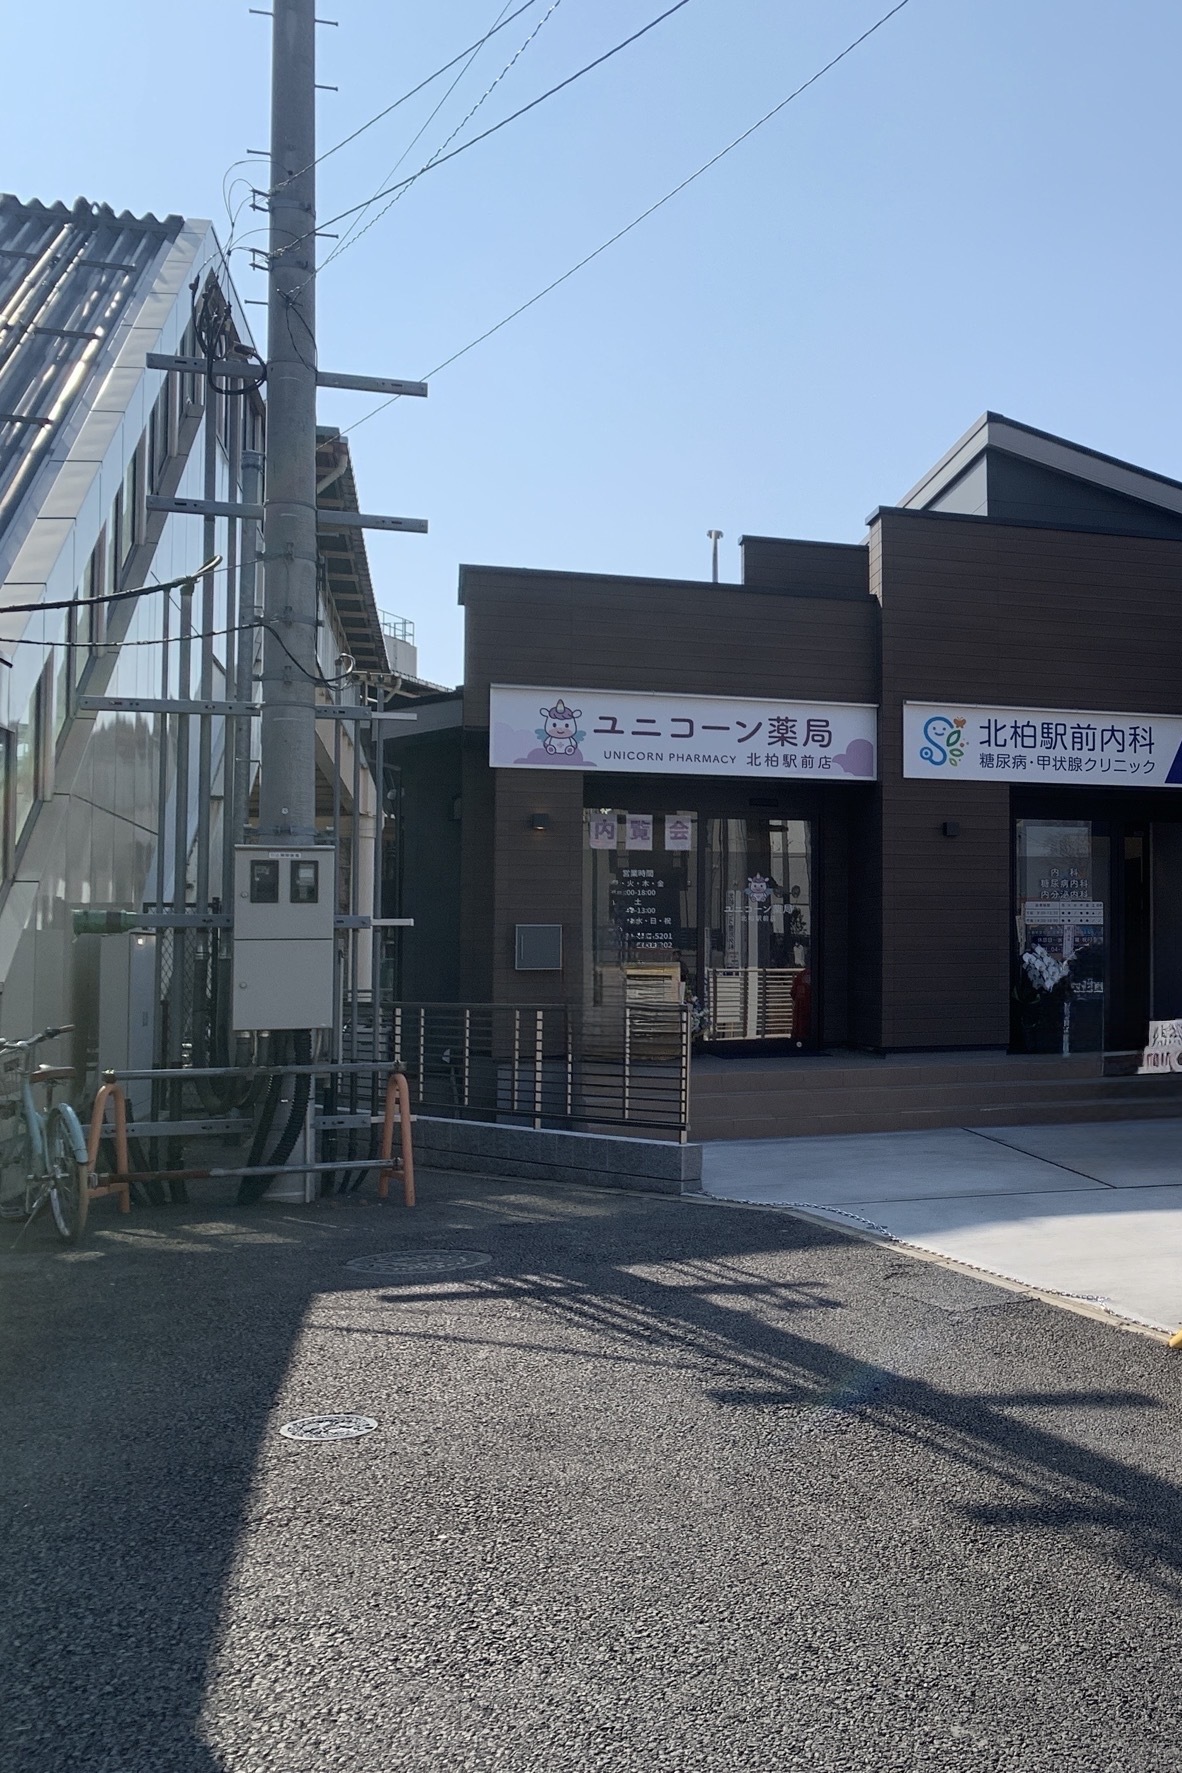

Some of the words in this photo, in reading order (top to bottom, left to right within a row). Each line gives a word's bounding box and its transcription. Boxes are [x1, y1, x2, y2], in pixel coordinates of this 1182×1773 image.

[593, 715, 833, 748] ユニコーン薬局
[979, 718, 1155, 755] 北柏駅前内科
[603, 750, 664, 762] UNICORN
[668, 752, 737, 764] PHARMACY
[746, 752, 832, 770] 北柏駅前店
[979, 752, 1156, 775] 糖尿病・甲状腺クリニック
